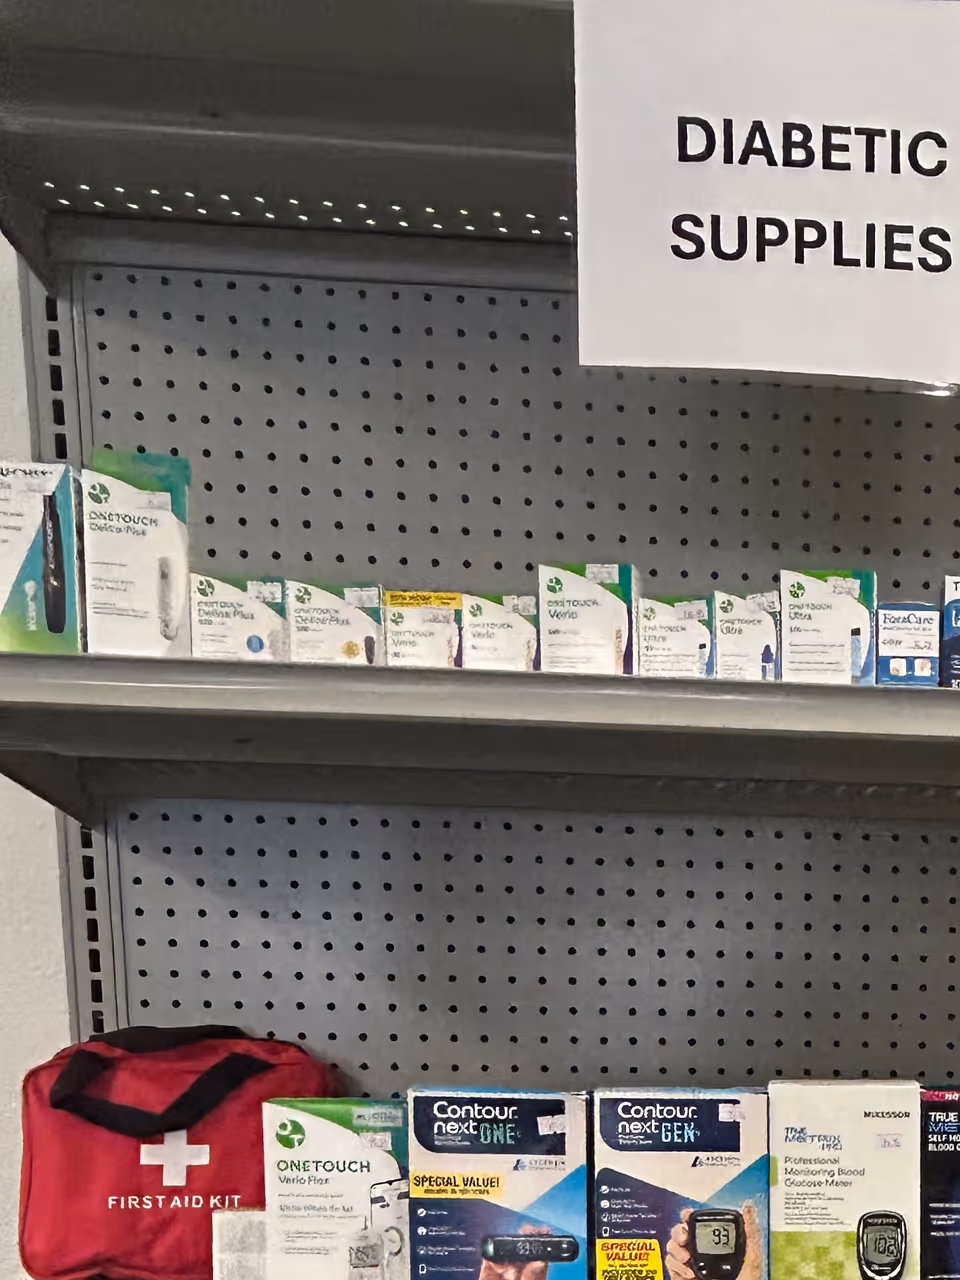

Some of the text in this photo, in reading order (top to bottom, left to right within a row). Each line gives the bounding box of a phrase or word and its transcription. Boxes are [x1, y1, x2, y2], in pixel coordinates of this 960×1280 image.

[677, 115, 948, 177] DIABETIC
[670, 213, 952, 273] SUPPLIES
[433, 1101, 518, 1119] Contour
[617, 1101, 698, 1119] Contour
[928, 1111, 959, 1122] TRUE
[433, 1119, 516, 1145] next ONE
[617, 1119, 696, 1143] next GEN
[928, 1133, 948, 1143] SELF
[276, 1160, 371, 1173] ONETOUCH
[784, 1156, 840, 1166] Professional
[784, 1167, 866, 1179] Monitoring Blood
[278, 1175, 306, 1185] Verio
[413, 1176, 500, 1188] SPECIAL VALUE!
[108, 1195, 242, 1209] FIRST AID KIT
[712, 1228, 731, 1246] 93
[601, 1240, 656, 1252] SPECIAL
